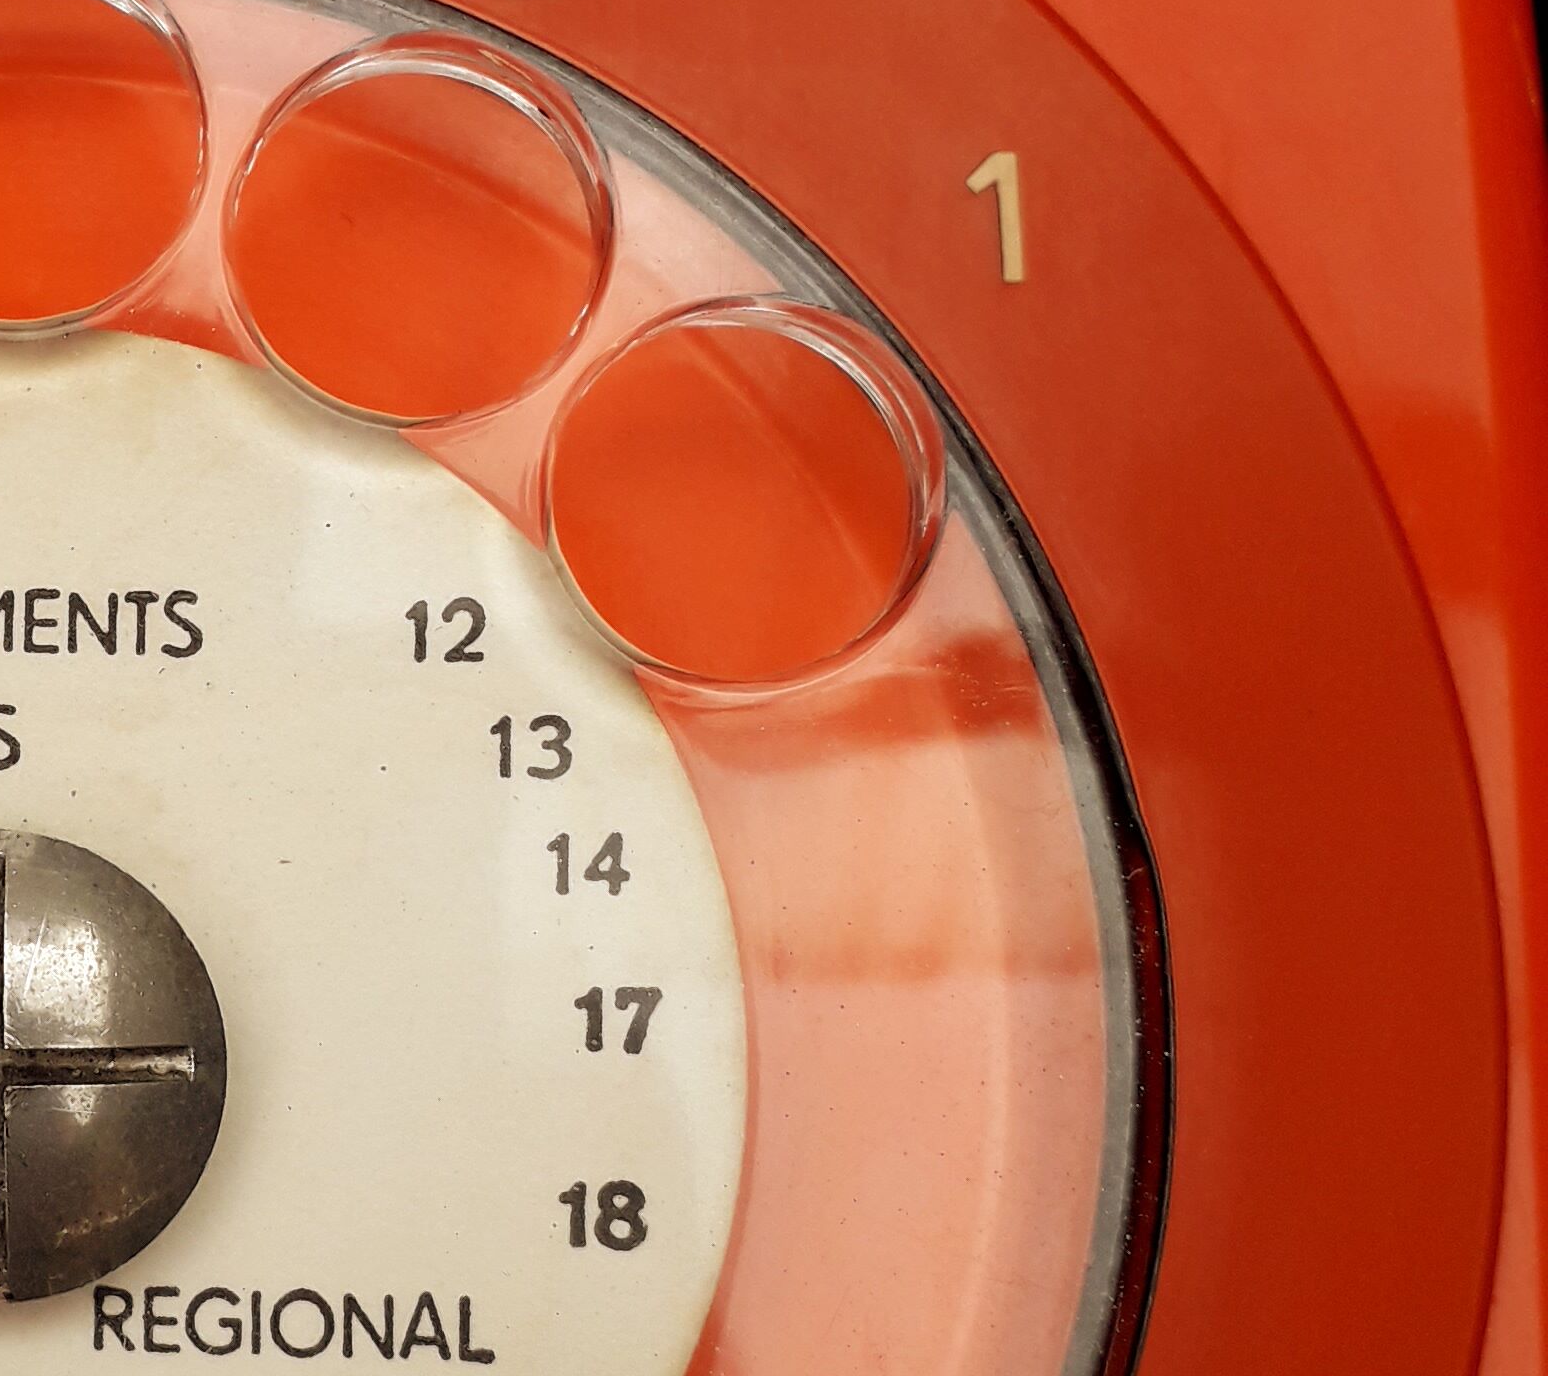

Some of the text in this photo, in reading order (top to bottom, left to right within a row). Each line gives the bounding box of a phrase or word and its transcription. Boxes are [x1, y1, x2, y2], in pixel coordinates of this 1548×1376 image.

[964, 151, 1025, 284] 1
[405, 596, 488, 664] 12
[488, 714, 573, 780] 13
[546, 831, 631, 896] 14
[573, 985, 664, 1056] 17
[557, 1178, 650, 1253] 18
[91, 1282, 497, 1366] REGIONAL
